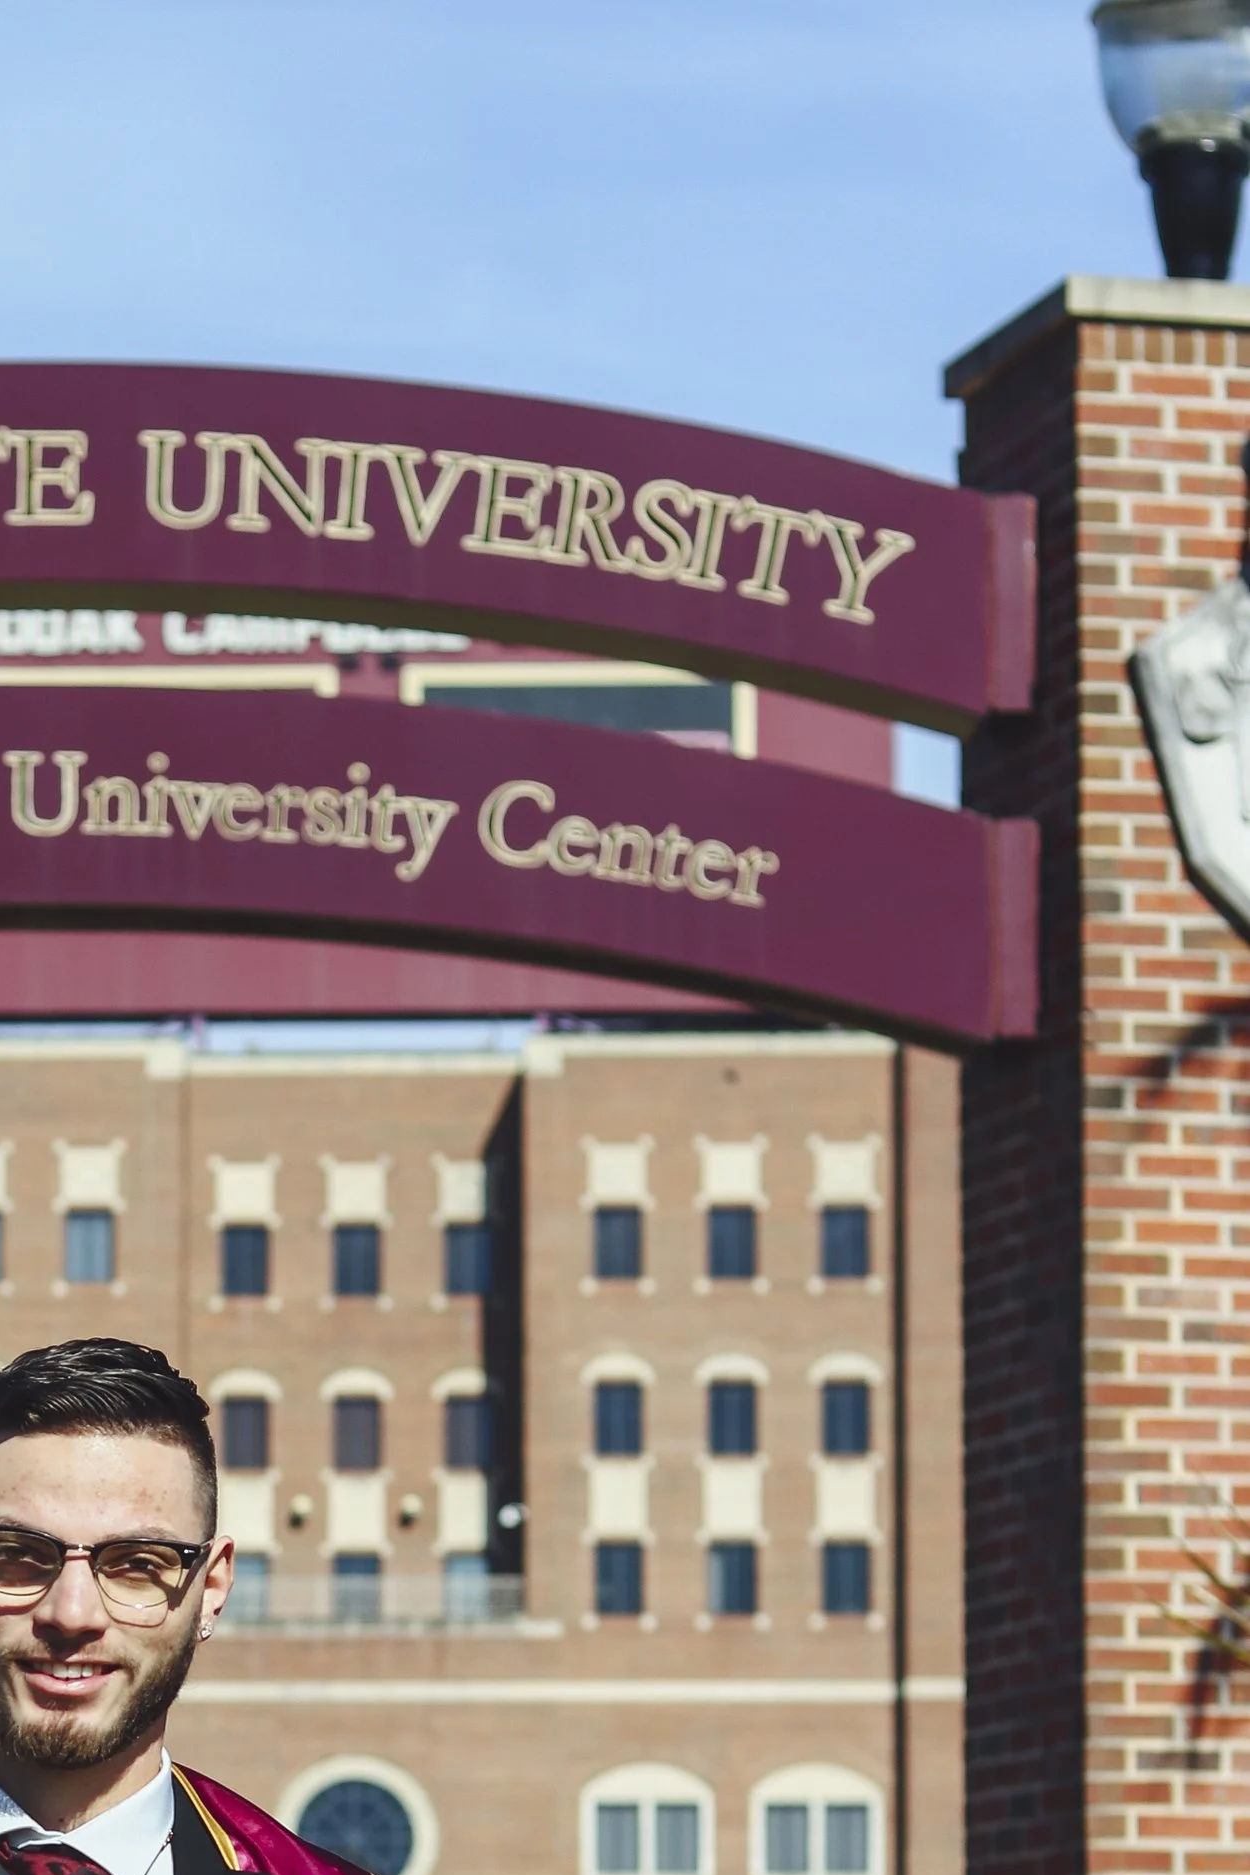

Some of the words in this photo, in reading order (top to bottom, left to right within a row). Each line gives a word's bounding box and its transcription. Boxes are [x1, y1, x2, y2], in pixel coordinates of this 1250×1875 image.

[138, 429, 916, 625] UNIVERSITY
[3, 750, 457, 881] University
[477, 779, 779, 908] Center
